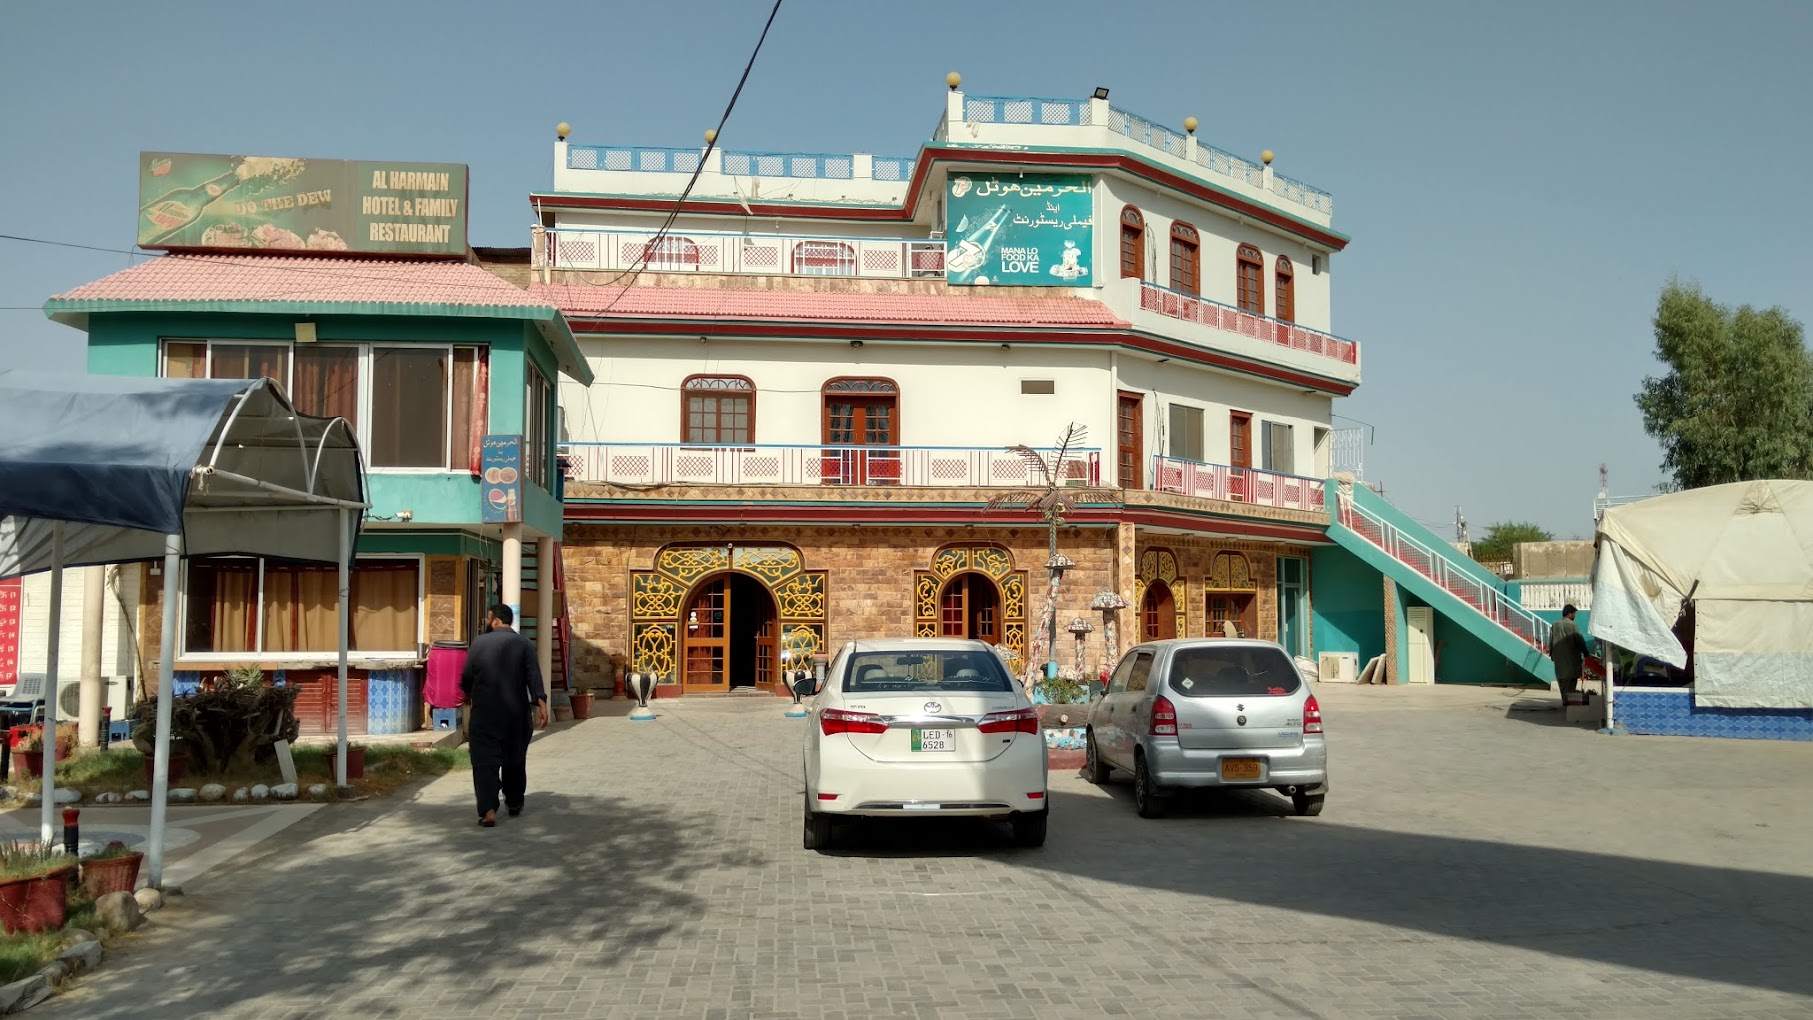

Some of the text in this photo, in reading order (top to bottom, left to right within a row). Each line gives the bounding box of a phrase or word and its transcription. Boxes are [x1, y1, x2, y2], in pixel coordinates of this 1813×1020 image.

[372, 170, 449, 191] AL HARMAIN
[236, 189, 332, 215] DO THE DEW
[362, 196, 459, 218] HOTEL & FAMILY
[369, 222, 451, 243] RESTAURANT
[1001, 261, 1040, 273] LOVE
[922, 740, 945, 749] 6528
